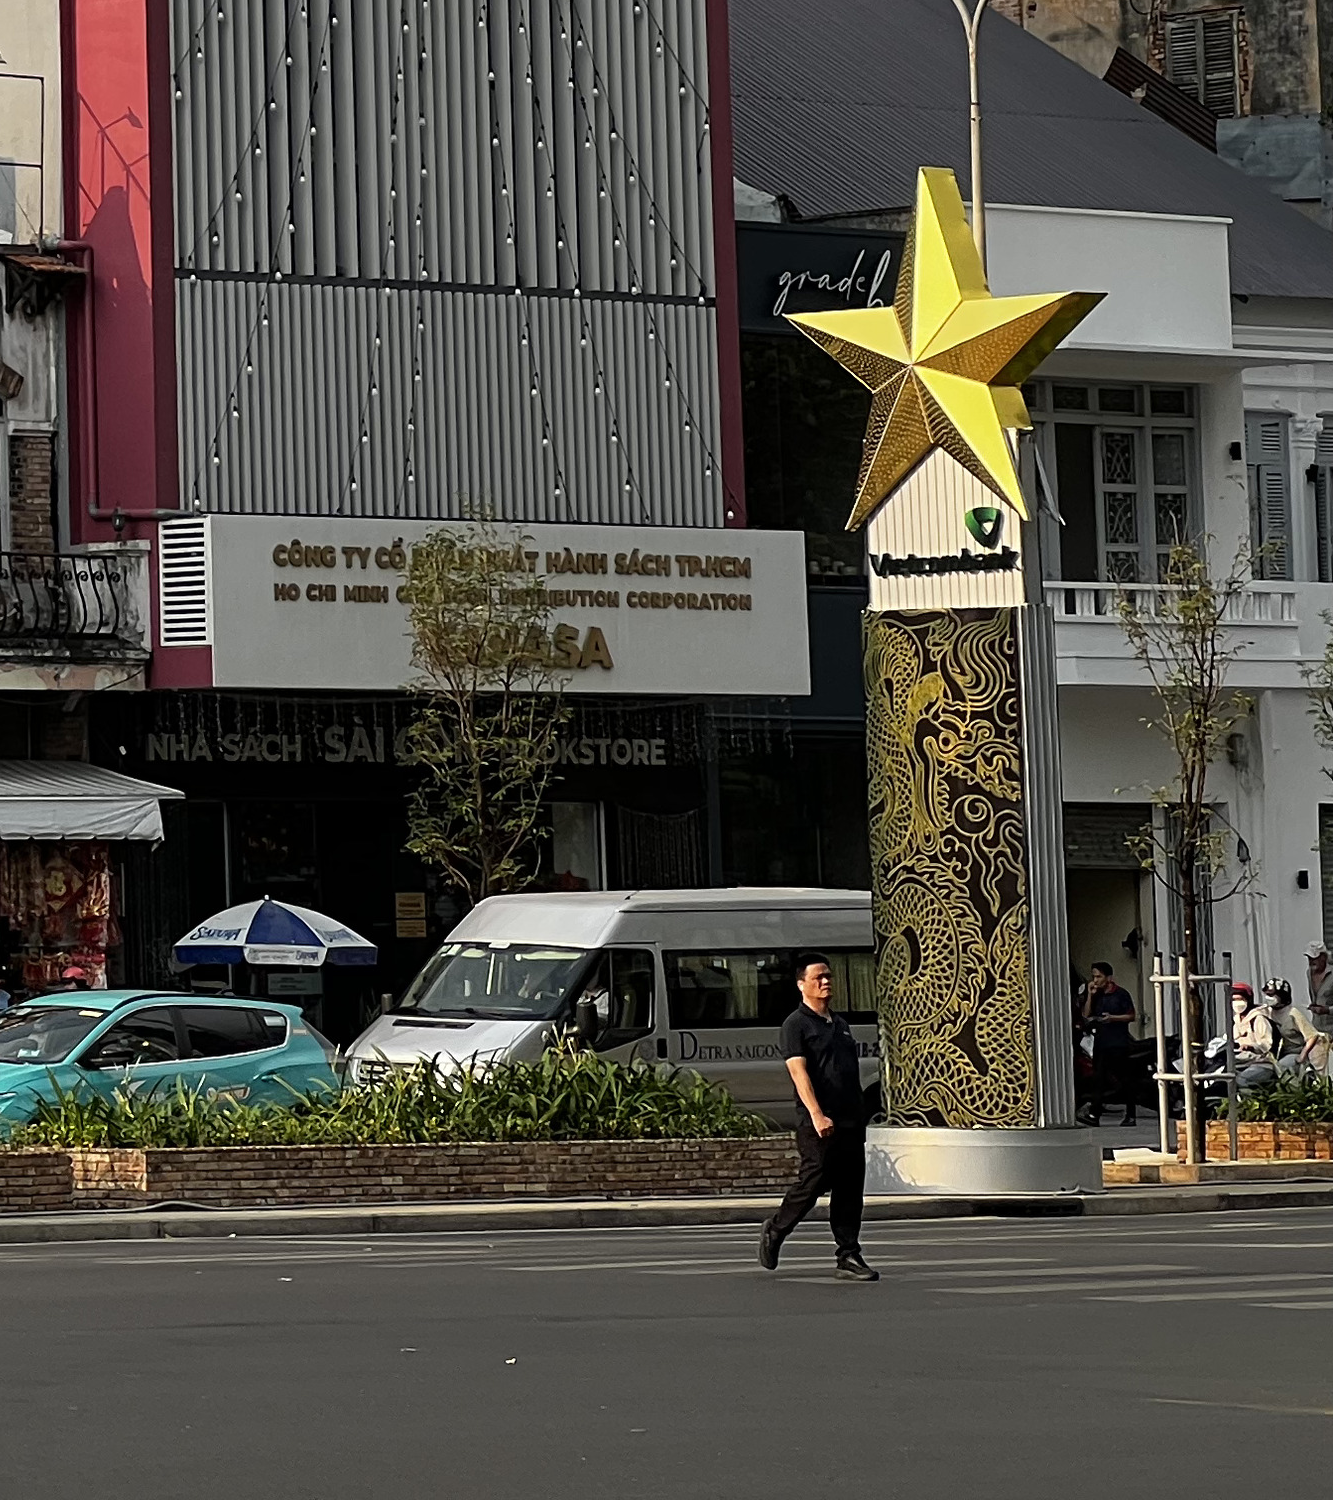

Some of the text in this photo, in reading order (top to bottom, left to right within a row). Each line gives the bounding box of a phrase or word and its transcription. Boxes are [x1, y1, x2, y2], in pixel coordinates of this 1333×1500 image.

[273, 538, 337, 568] CÔNG
[342, 547, 371, 569] TY
[546, 547, 608, 575] HÀNH
[614, 548, 671, 577] SÁCH
[675, 554, 751, 579] TP.HCM
[274, 583, 300, 602] HO
[306, 583, 336, 602] CHI
[344, 585, 389, 603] MINH
[627, 591, 752, 611] CORPORATION
[501, 737, 667, 766] OKSTORE
[678, 1030, 731, 1060] DETRA
